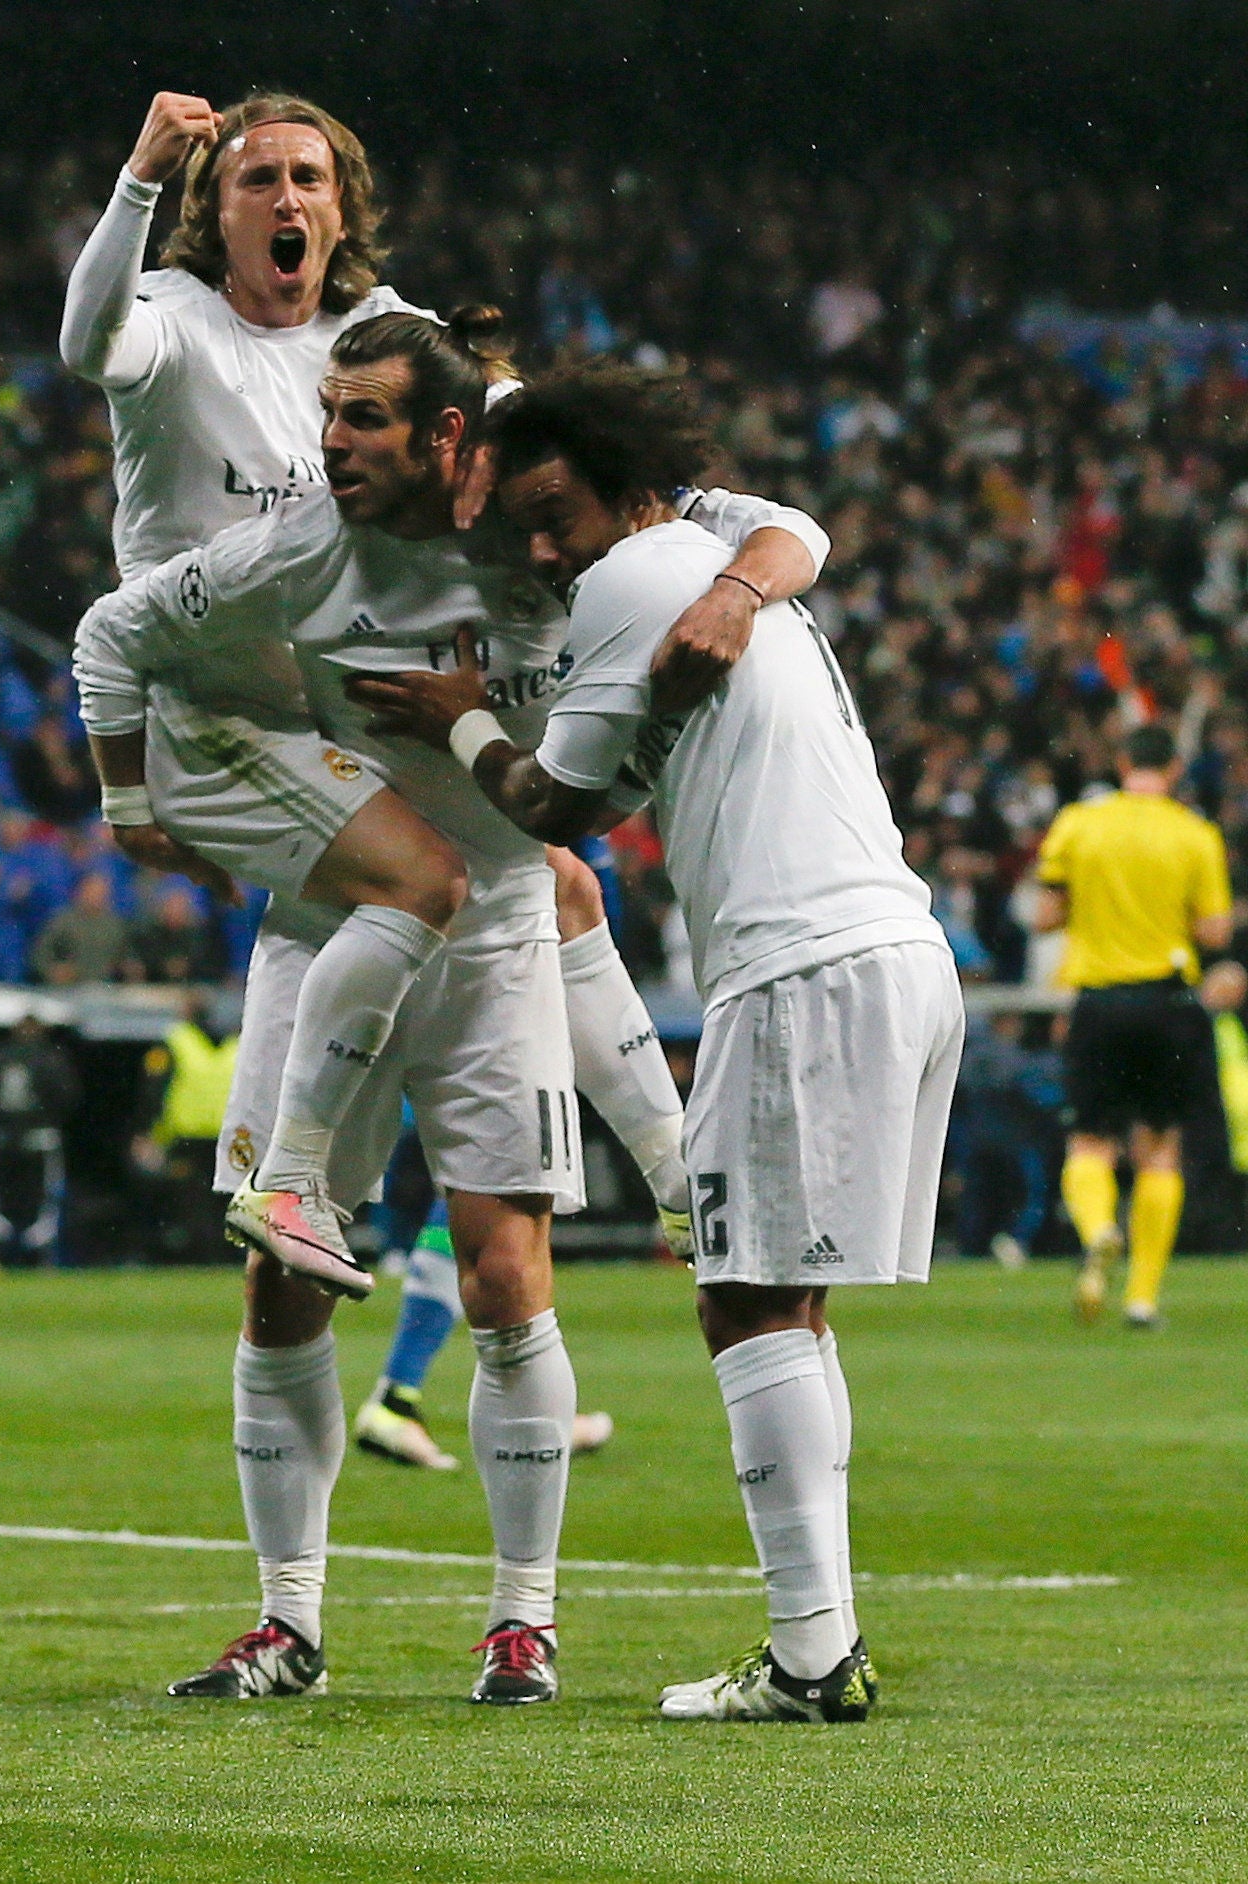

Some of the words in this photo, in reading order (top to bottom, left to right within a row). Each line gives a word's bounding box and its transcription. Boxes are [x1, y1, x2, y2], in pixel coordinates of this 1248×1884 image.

[326, 1039, 376, 1067] RMC
[536, 1087, 571, 1172] 11
[688, 1172, 728, 1257] 2
[800, 1253, 844, 1265] adidas
